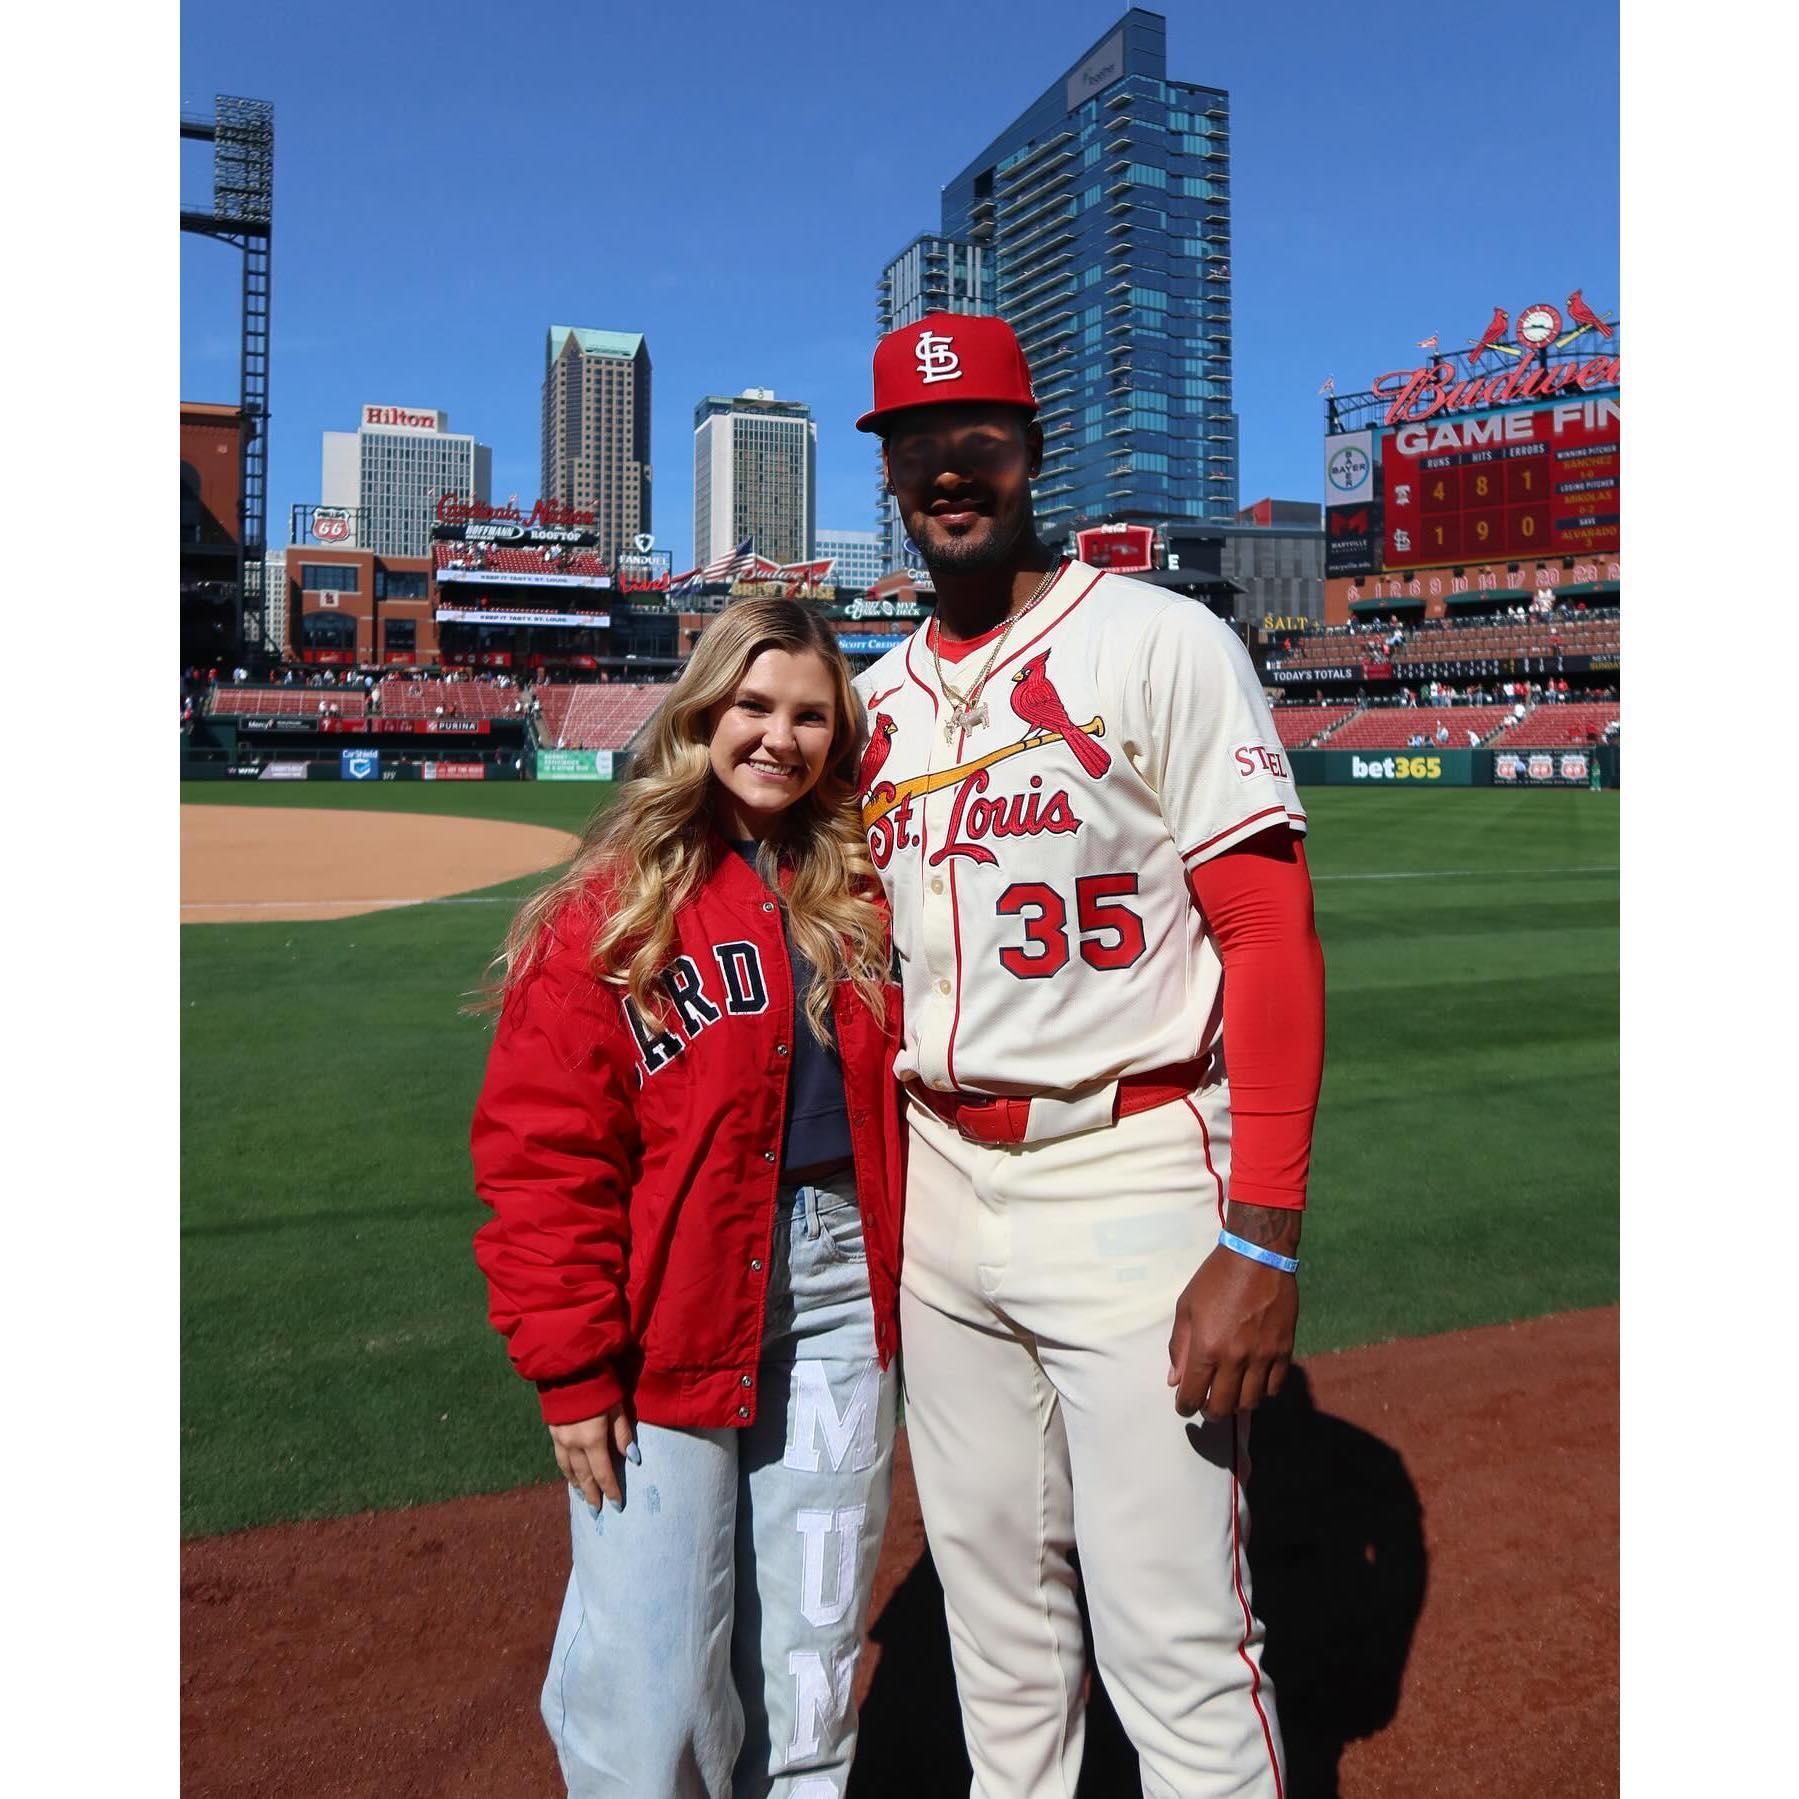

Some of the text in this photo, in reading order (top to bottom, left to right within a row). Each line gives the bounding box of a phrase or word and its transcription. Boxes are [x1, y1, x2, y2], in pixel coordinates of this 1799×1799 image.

[366, 407, 434, 428] Hilton
[1397, 412, 1533, 455] GAME
[1427, 444, 1545, 468] RUNS HITS ERRORS
[1332, 463, 1366, 475] BAYER
[1433, 482, 1444, 500] 4
[1476, 476, 1488, 496] 8
[1522, 471, 1531, 490] 1
[319, 523, 343, 535] 66
[466, 524, 581, 542] HOFFMANN ROOFTOP
[1435, 517, 1534, 545] 1 9 0
[1264, 615, 1308, 630] SALT
[1274, 668, 1352, 681] TODAY'S TOTALS
[439, 722, 476, 730] PURINA
[342, 750, 378, 759] CarShield
[1352, 755, 1442, 778] bet365
[867, 769, 1083, 870] St. Louis
[996, 872, 1147, 980] 35
[635, 940, 769, 1091] ARD
[782, 1358, 883, 1799] MUN
